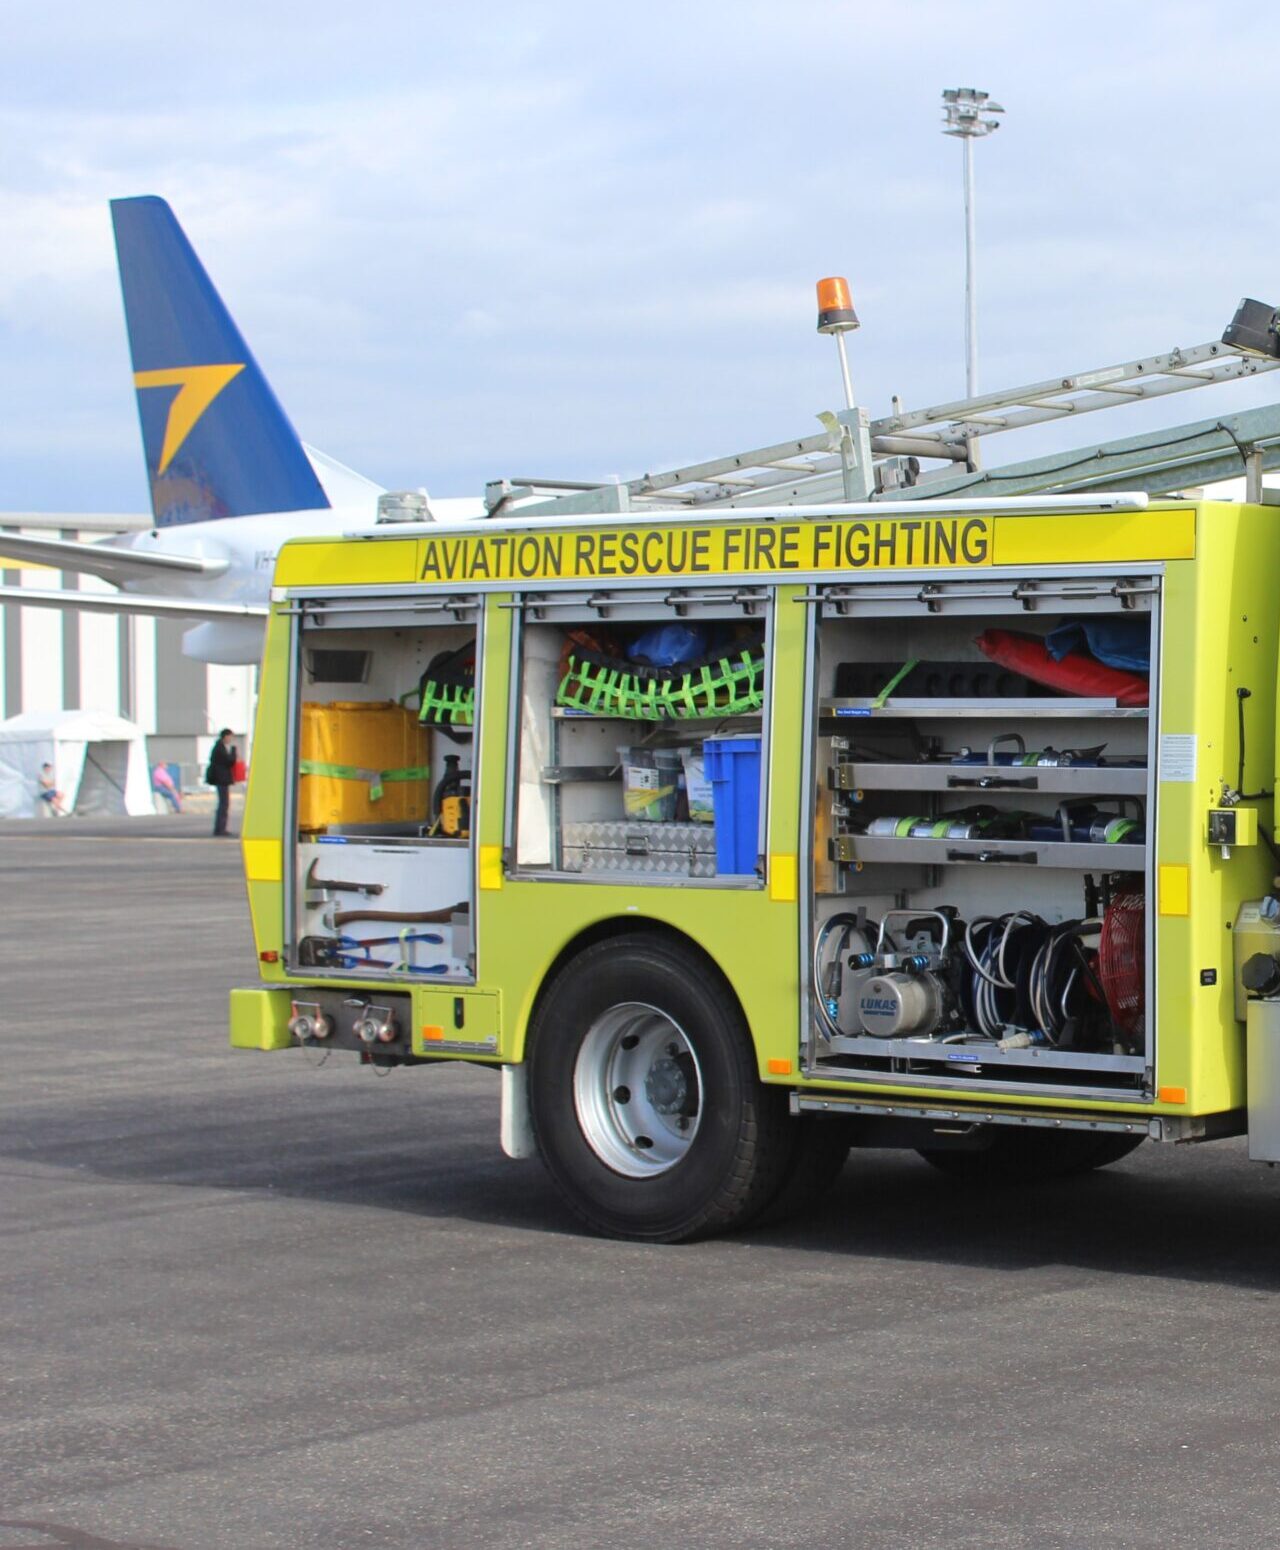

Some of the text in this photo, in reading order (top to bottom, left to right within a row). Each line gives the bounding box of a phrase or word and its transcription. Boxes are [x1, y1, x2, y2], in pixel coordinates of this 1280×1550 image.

[420, 519, 988, 580] AVIATION RESCUE FIRE FIGHTING
[860, 998, 898, 1010] LUKAS
